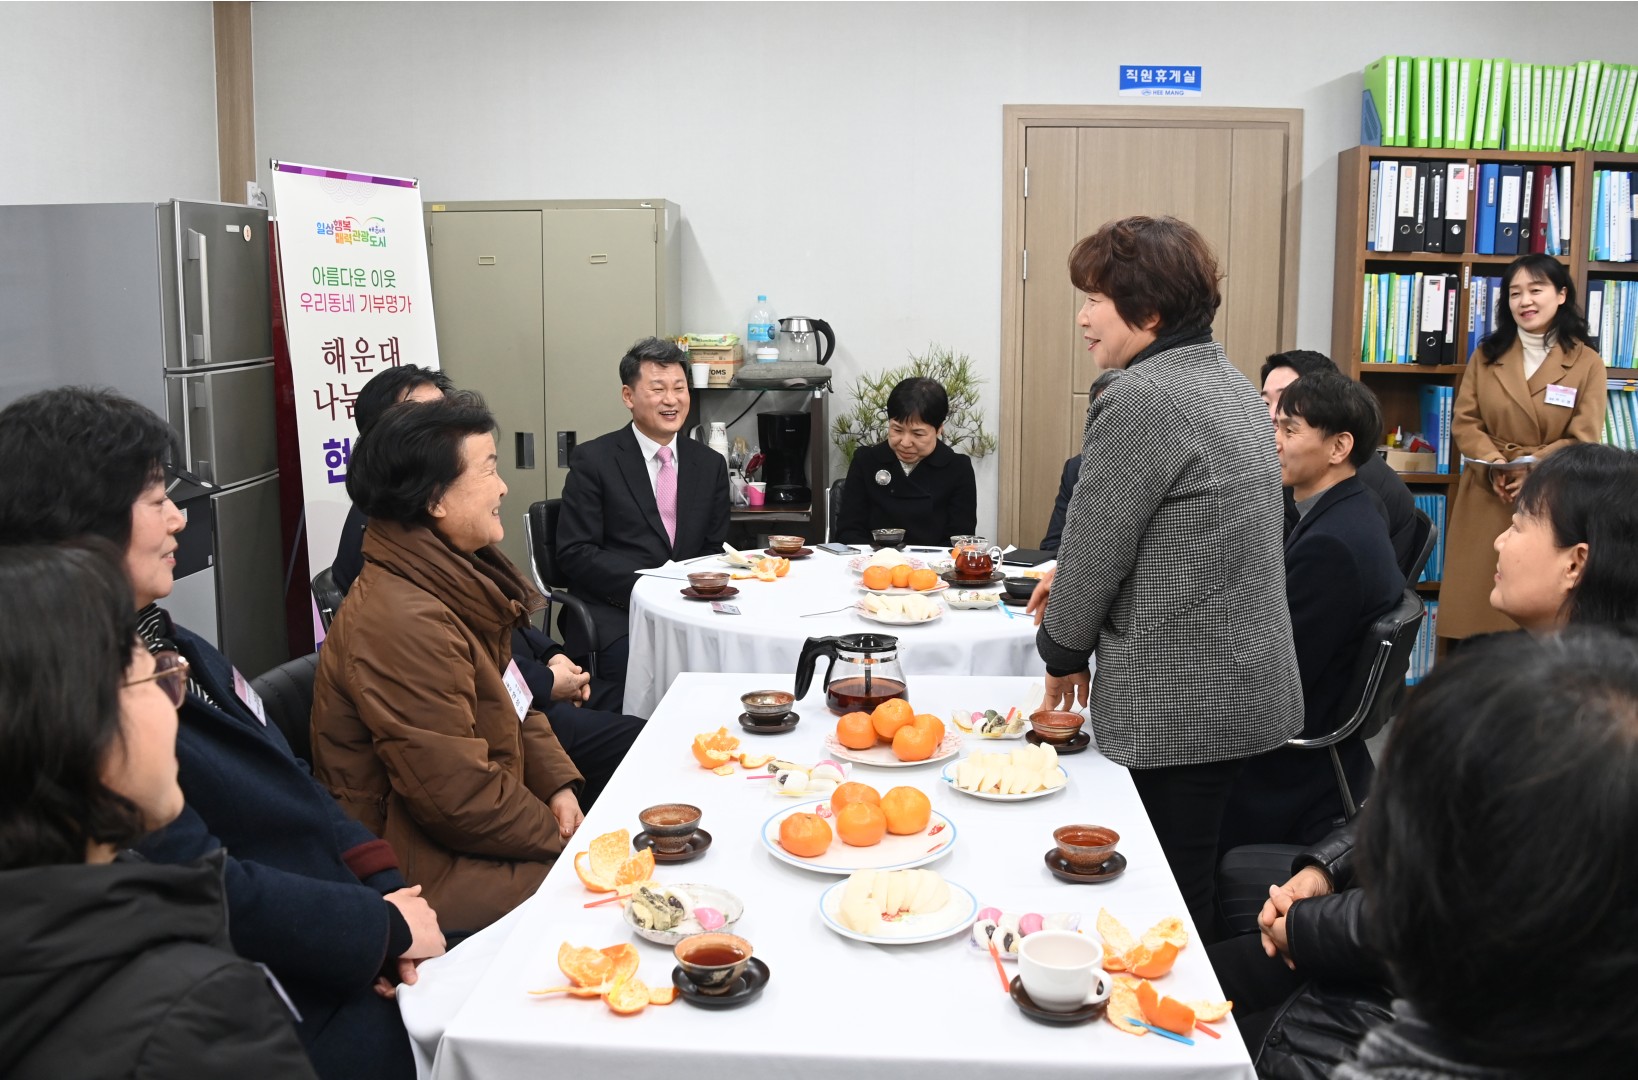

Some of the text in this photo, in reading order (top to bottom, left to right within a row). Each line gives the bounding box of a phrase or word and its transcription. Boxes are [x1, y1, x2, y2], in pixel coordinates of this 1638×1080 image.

[1126, 69, 1196, 84] 직원휴게실
[369, 235, 387, 248] 도시
[312, 266, 396, 289] 아름다운 이웃
[300, 292, 412, 314] 우리동네 기부명가
[321, 336, 401, 375] 해운대
[322, 437, 351, 485] 현
